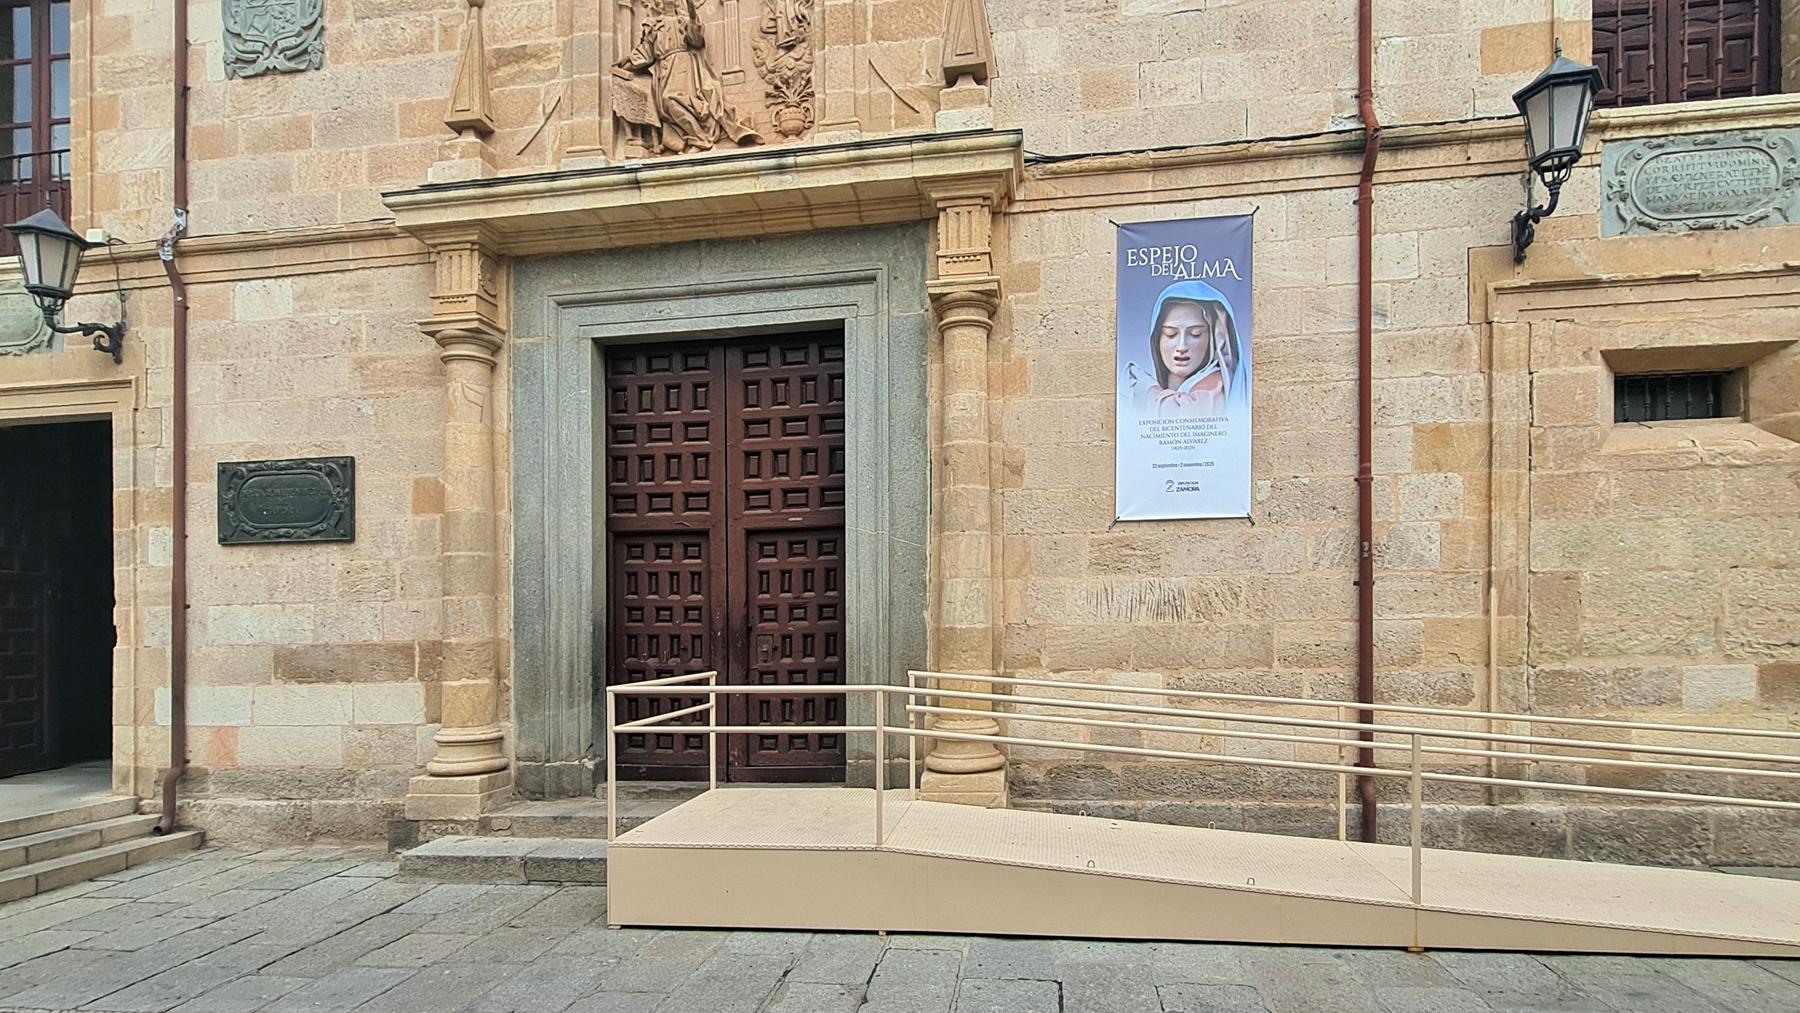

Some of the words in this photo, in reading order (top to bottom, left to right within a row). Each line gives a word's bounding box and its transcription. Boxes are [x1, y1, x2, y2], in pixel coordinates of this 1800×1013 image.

[1127, 245, 1198, 267] ESPEJO
[1151, 262, 1182, 277] DEL
[1173, 258, 1243, 281] ALMA
[1162, 424, 1206, 432] BICENTENARIO
